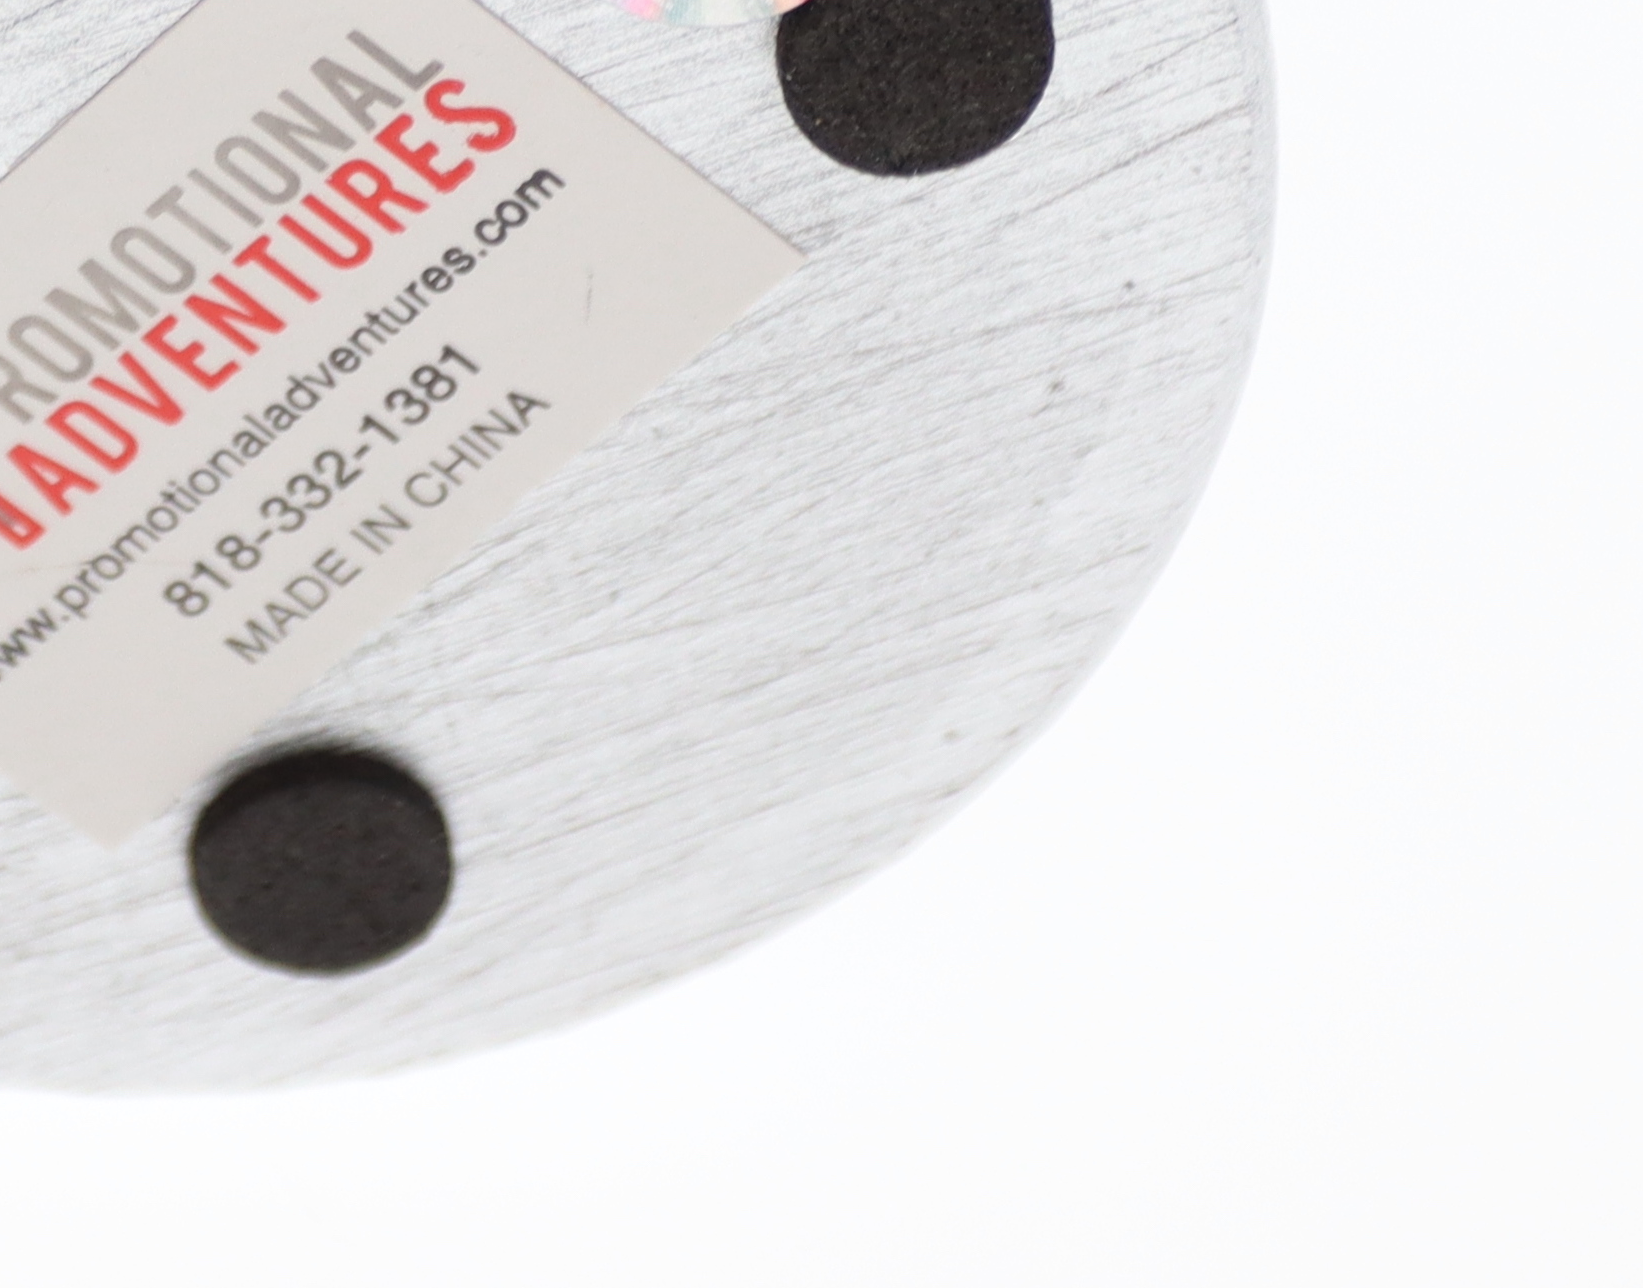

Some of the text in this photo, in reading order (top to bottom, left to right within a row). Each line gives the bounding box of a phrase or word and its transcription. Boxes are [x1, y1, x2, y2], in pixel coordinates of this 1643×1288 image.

[6, 77, 518, 515] ADVENTURES
[163, 343, 482, 619] 818-332-1381
[223, 387, 553, 665] MADE IN CHINA
